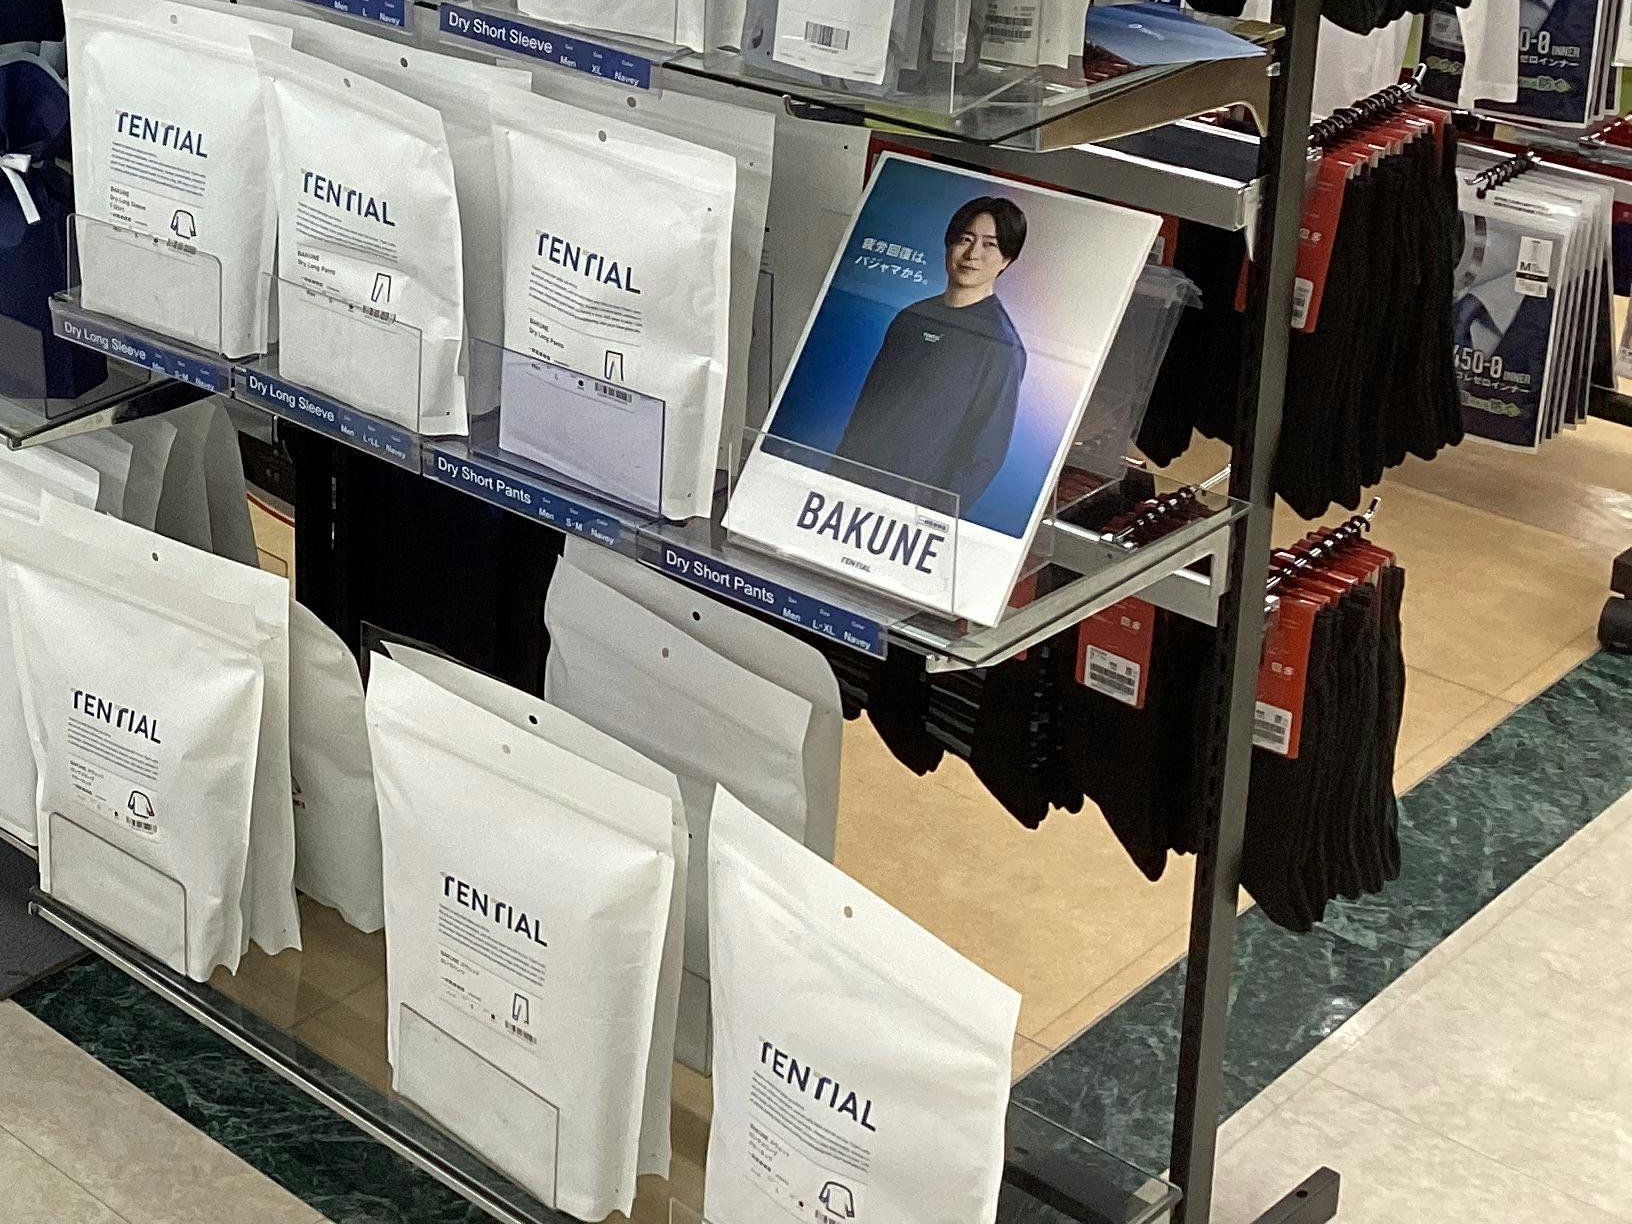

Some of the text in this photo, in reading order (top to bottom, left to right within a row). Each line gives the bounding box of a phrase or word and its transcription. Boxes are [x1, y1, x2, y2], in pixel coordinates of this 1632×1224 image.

[448, 11, 470, 33] Dry
[473, 19, 506, 41] Short
[509, 29, 553, 54] Sleeve
[559, 55, 577, 68] Men
[115, 109, 208, 159] TENTIAL
[300, 167, 396, 227] TENTIAL
[536, 229, 642, 294] TENTIAL
[1519, 261, 1532, 272] M
[63, 320, 82, 338] Dry
[84, 327, 110, 351] Long
[111, 337, 146, 361] Sleeve
[249, 376, 267, 396] Dry
[269, 383, 296, 409] Long
[298, 396, 335, 422] Sleeve
[437, 456, 459, 478] Dry
[461, 466, 494, 491] Short
[495, 478, 532, 505] Pants
[538, 506, 555, 521] Men
[797, 491, 945, 575] BAKUNE
[666, 548, 690, 572] Dry
[693, 559, 731, 589] Short
[733, 576, 775, 605] Pants
[781, 606, 801, 623] Men
[843, 630, 871, 651] Navey
[70, 687, 161, 745] TENTIAL
[440, 871, 548, 948] TENTIAL
[759, 1036, 876, 1133] TENTIAL
